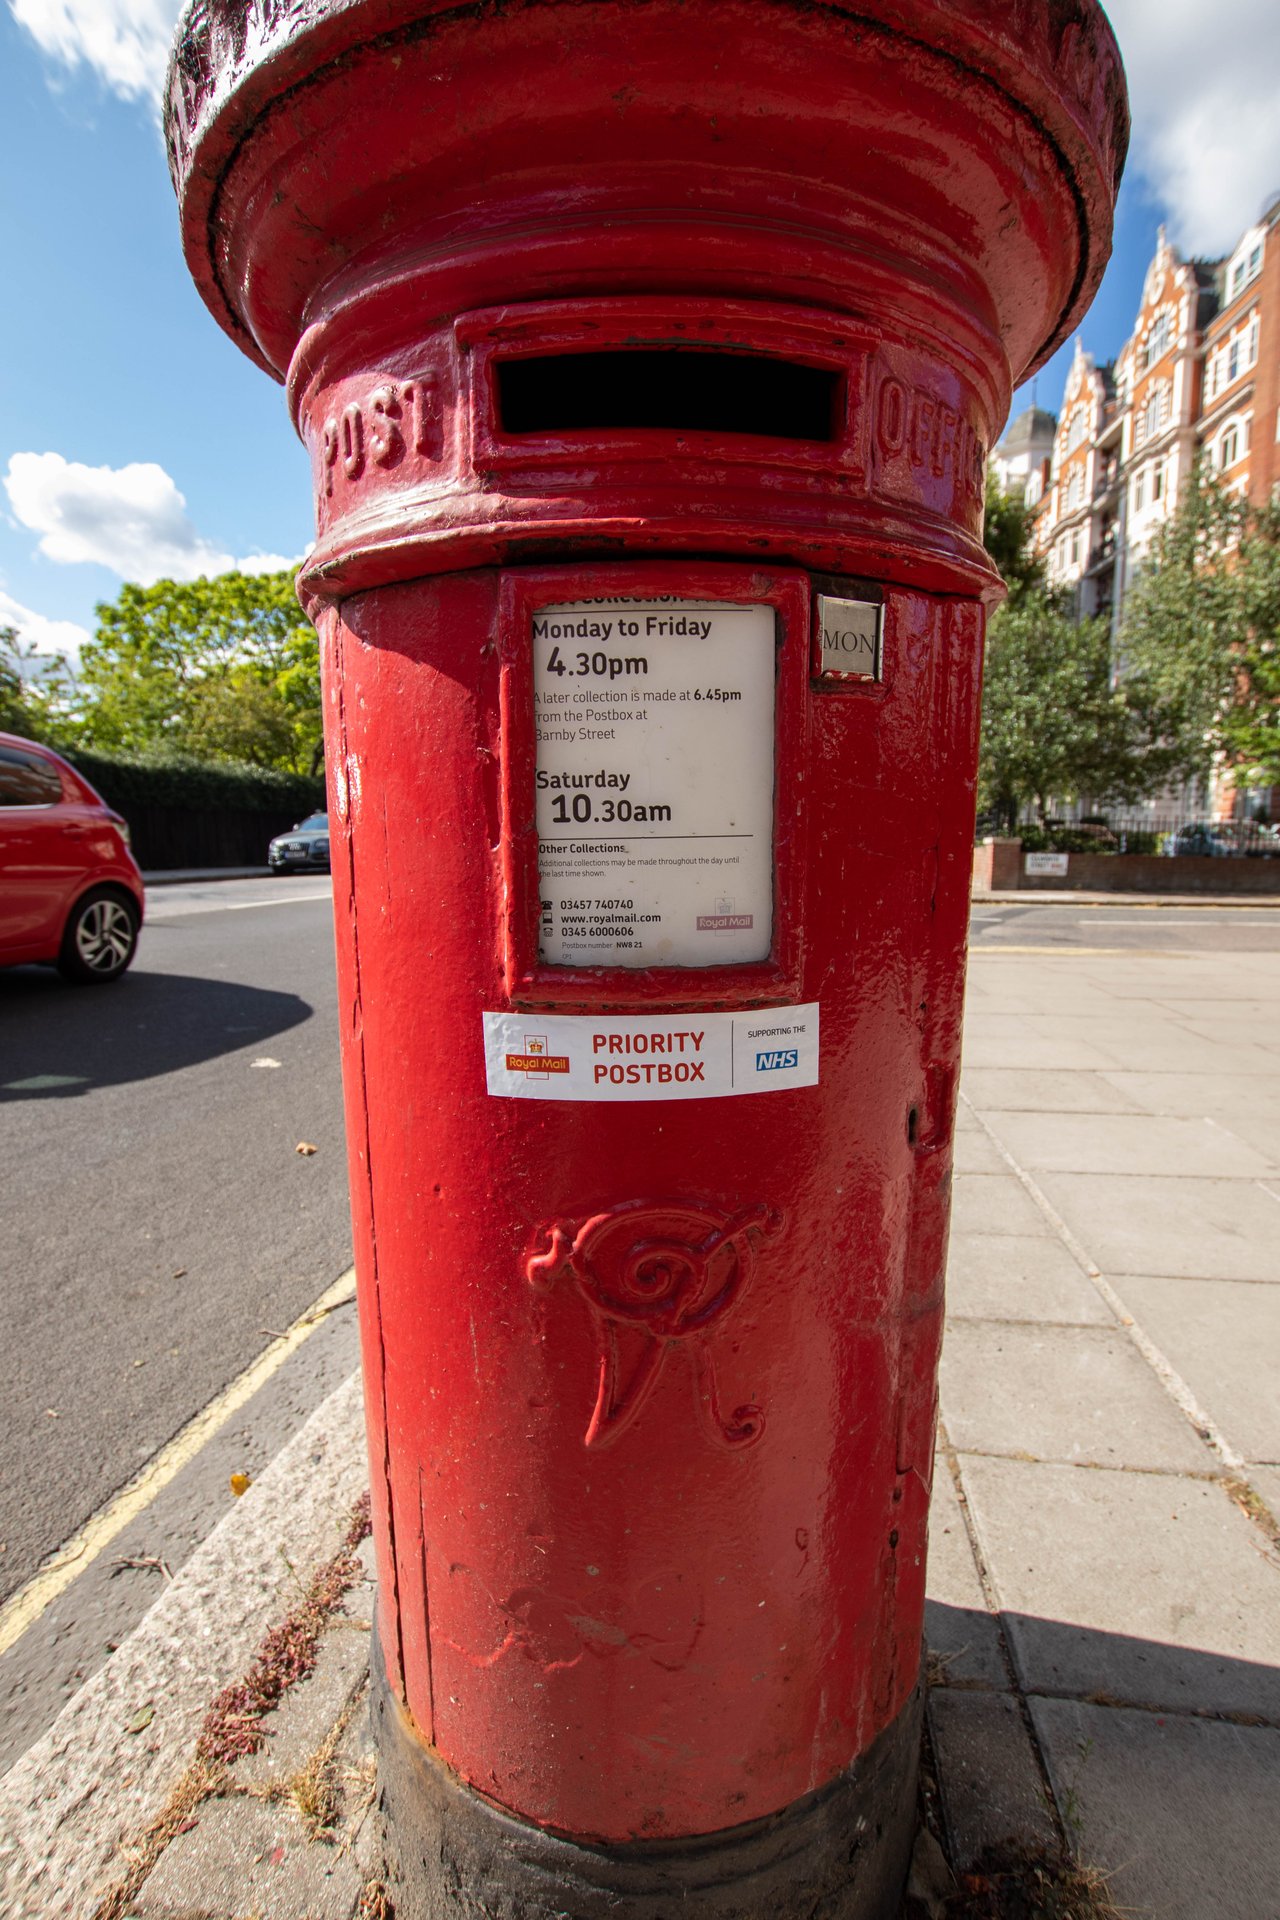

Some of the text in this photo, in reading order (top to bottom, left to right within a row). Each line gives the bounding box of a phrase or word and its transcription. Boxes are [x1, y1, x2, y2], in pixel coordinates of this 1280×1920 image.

[322, 370, 441, 498] POST
[532, 616, 712, 641] Monday to Friday
[823, 629, 875, 654] MON
[547, 646, 648, 680] 4.30pm
[533, 688, 742, 704] A later collection is made at 6.45pm
[564, 709, 583, 721] the
[586, 709, 633, 721] Postbox
[636, 709, 648, 720] at
[535, 727, 616, 743] Barnby Street
[536, 769, 631, 791] Saturday
[551, 793, 672, 823] 10.30am
[538, 843, 625, 854] Other Collections
[539, 856, 740, 868] Additional collections may be made throughout the day until
[538, 870, 551, 878] the
[565, 869, 580, 877] time
[582, 869, 606, 877] shown.
[560, 899, 634, 910] 03457 740740
[560, 913, 661, 925] www.royalmail.com
[699, 916, 751, 929] Royal Mail
[561, 927, 634, 937] 0345 6000606
[561, 941, 587, 949] Postbox
[616, 941, 633, 949] NW8
[634, 941, 643, 949] 21
[747, 1025, 806, 1038] SUPPORTING THE
[593, 1031, 704, 1054] PRIORITY
[509, 1056, 566, 1070] Royal Mail
[758, 1050, 796, 1070] NHS
[594, 1061, 705, 1084] POSTBOX
